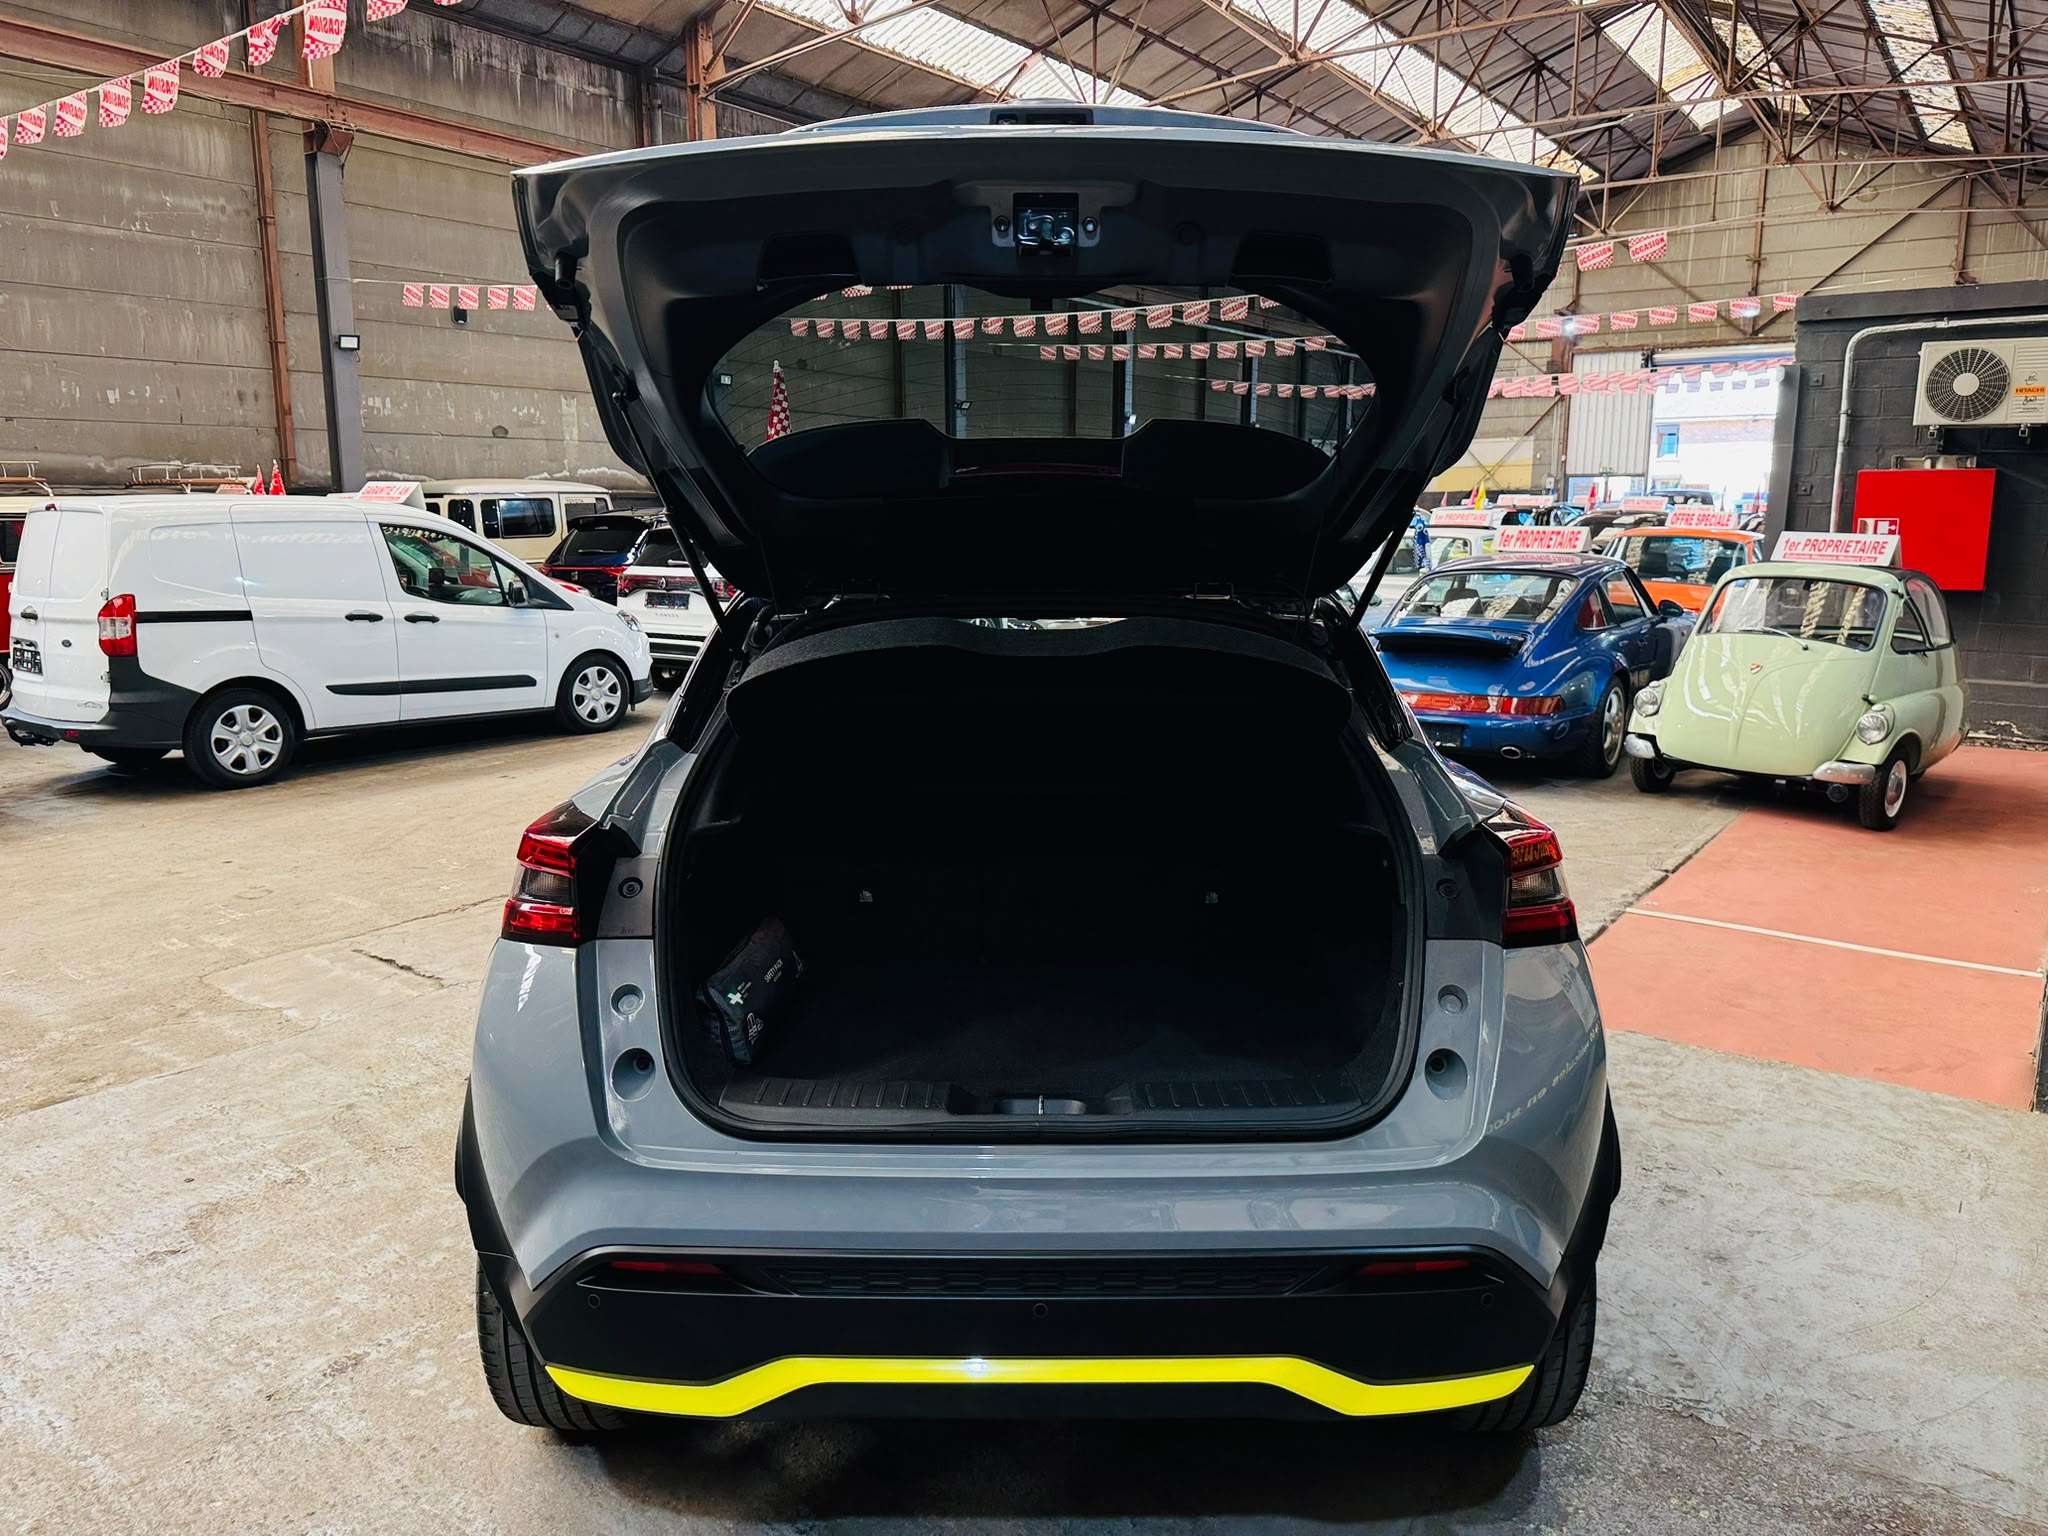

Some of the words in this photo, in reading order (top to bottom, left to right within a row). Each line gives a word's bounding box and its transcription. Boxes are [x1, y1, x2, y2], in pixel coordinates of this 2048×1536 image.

[1221, 300, 1248, 317] OCCASION
[1671, 512, 1696, 526] OFFRE
[1697, 513, 1733, 527] SPECIALE
[1500, 530, 1515, 548] 1er
[1514, 530, 1582, 549] PROPRIETAIRE
[1783, 539, 1801, 552] 1er
[1802, 539, 1889, 555] PROPRIETAIRE
